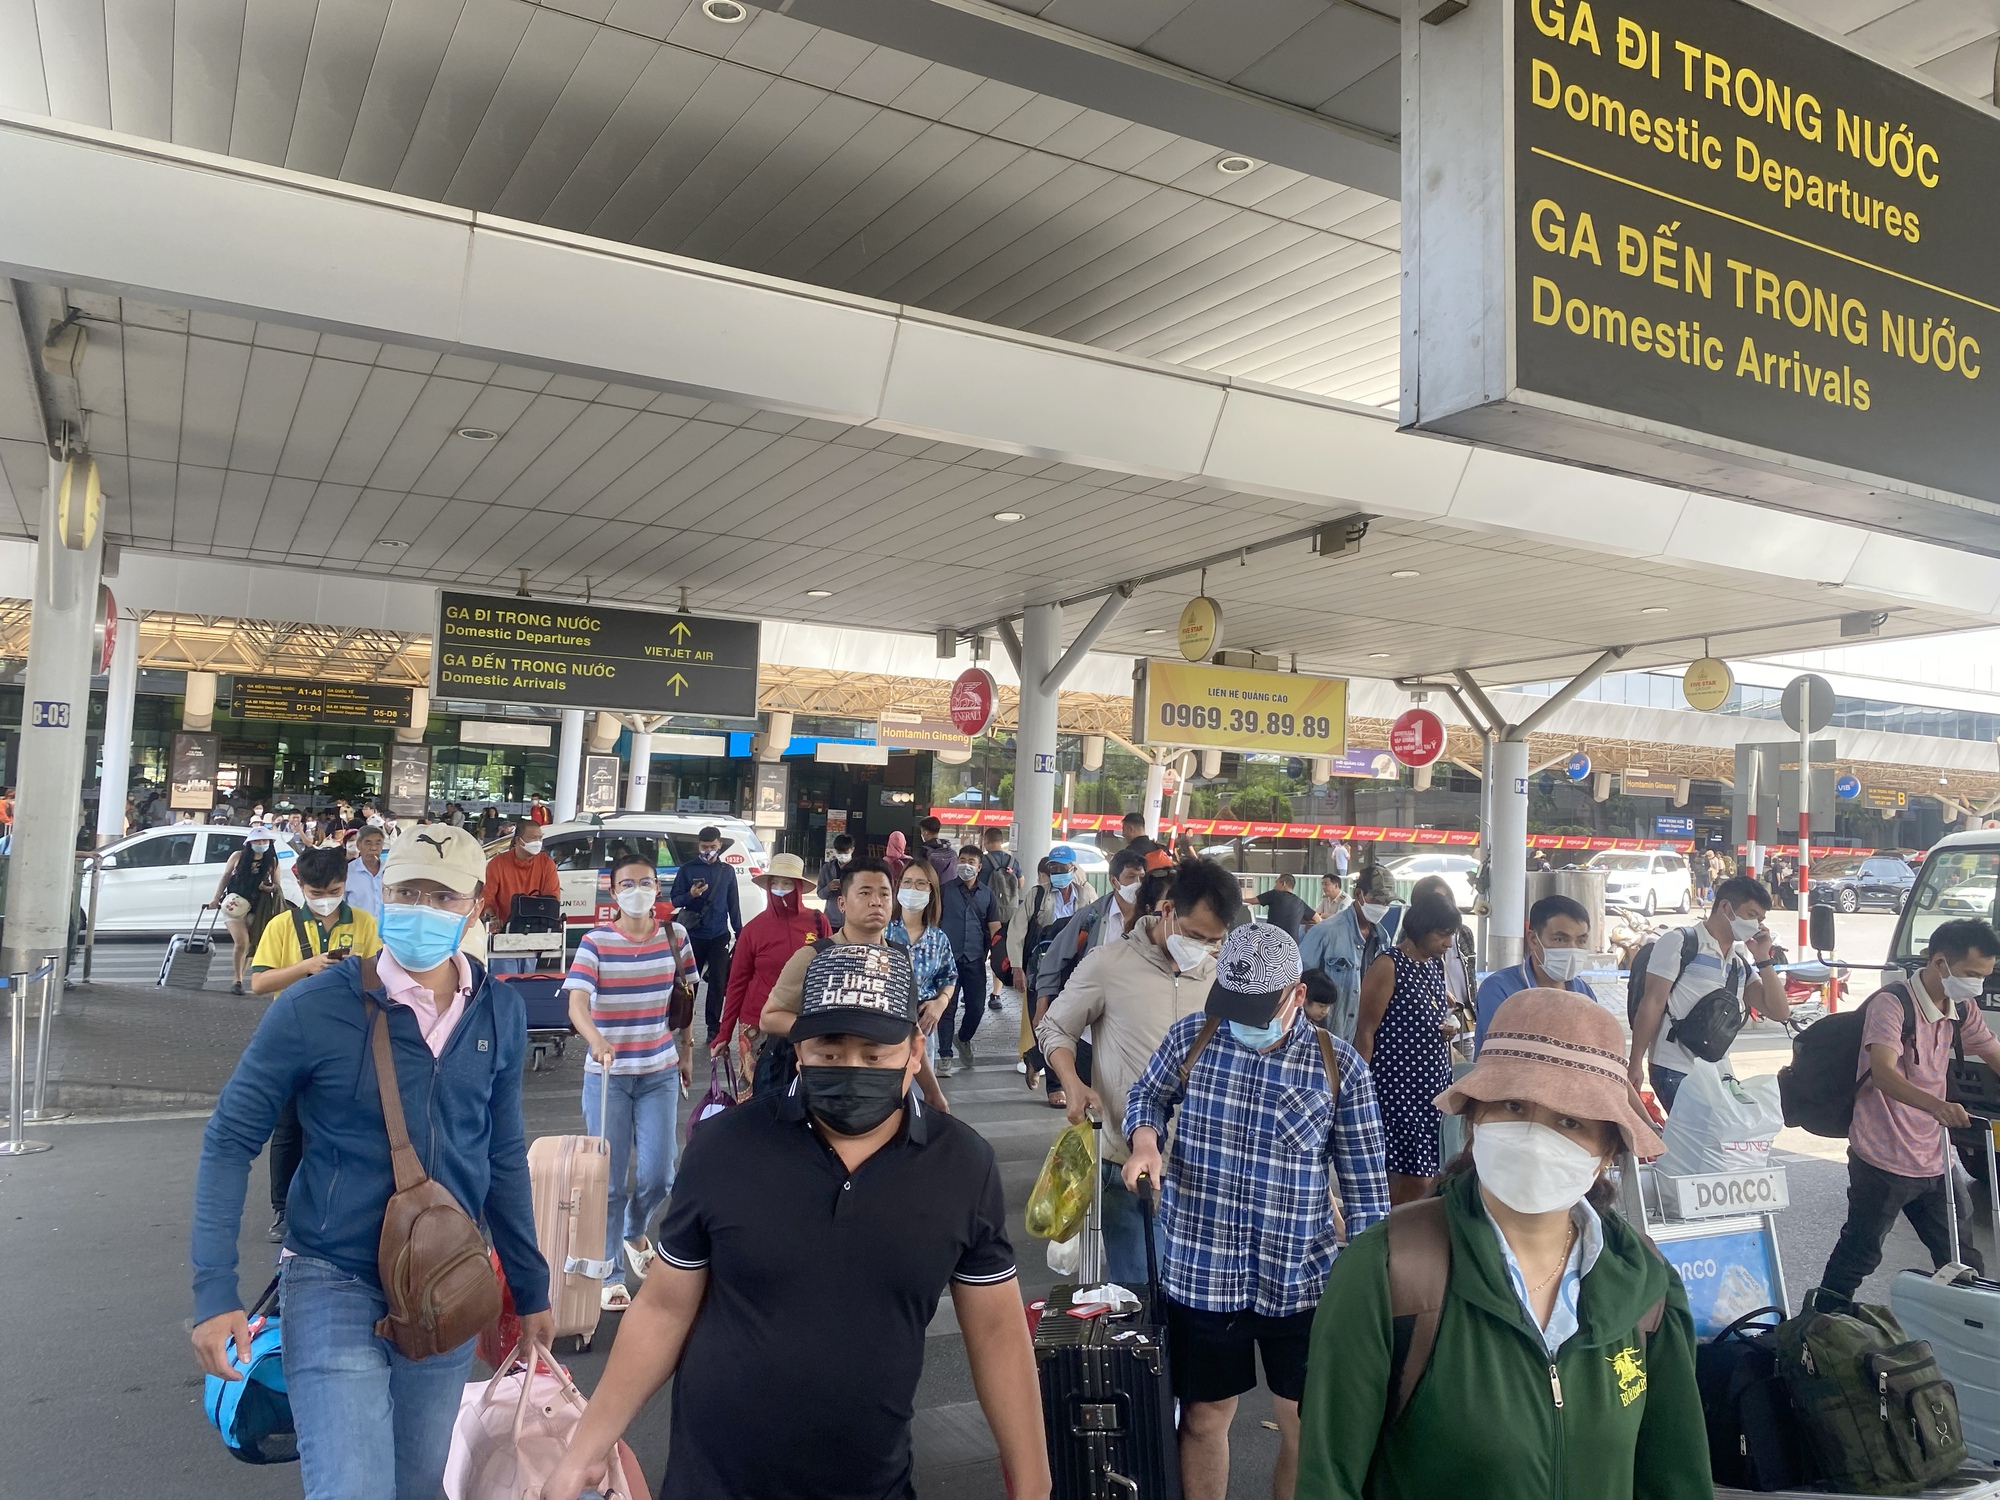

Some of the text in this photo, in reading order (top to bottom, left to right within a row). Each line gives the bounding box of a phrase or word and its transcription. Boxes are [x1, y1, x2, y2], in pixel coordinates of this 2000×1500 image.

[1531, 0, 1941, 189] GA ĐI TRONG NƯỚC
[1532, 58, 1921, 243] Domestic Departures
[1531, 198, 1982, 381] GA ĐẾN TRONG NƯỚC
[1532, 275, 1872, 412] Domestic Arrivals
[446, 606, 601, 632] GA ĐI TRONG NƯỚC
[445, 623, 591, 647] Domestic Departures
[644, 646, 714, 661] VIETJET AIR
[443, 652, 616, 679] GA ĐẾN TRONG NƯỚC
[441, 670, 567, 691] Domestic Arrivals
[298, 688, 322, 696] A1-A3
[1208, 687, 1288, 704] LIÊN HỆ QUẢNG CÁO
[33, 703, 70, 725] B-03
[296, 704, 321, 712] D1-D4
[373, 709, 398, 717] D5-D8
[953, 711, 982, 721] ENERALI
[1160, 702, 1330, 740] 0969.39.89.89
[882, 727, 969, 744] Homtamin Ginseng
[1627, 780, 1676, 791] Homtamin Ginseng
[1898, 792, 1905, 805] B
[1686, 819, 1693, 830] B
[828, 973, 885, 992] I like
[821, 988, 889, 1011] black
[1697, 1178, 1771, 1207] DORCO
[1671, 1259, 1717, 1281] ORCO
